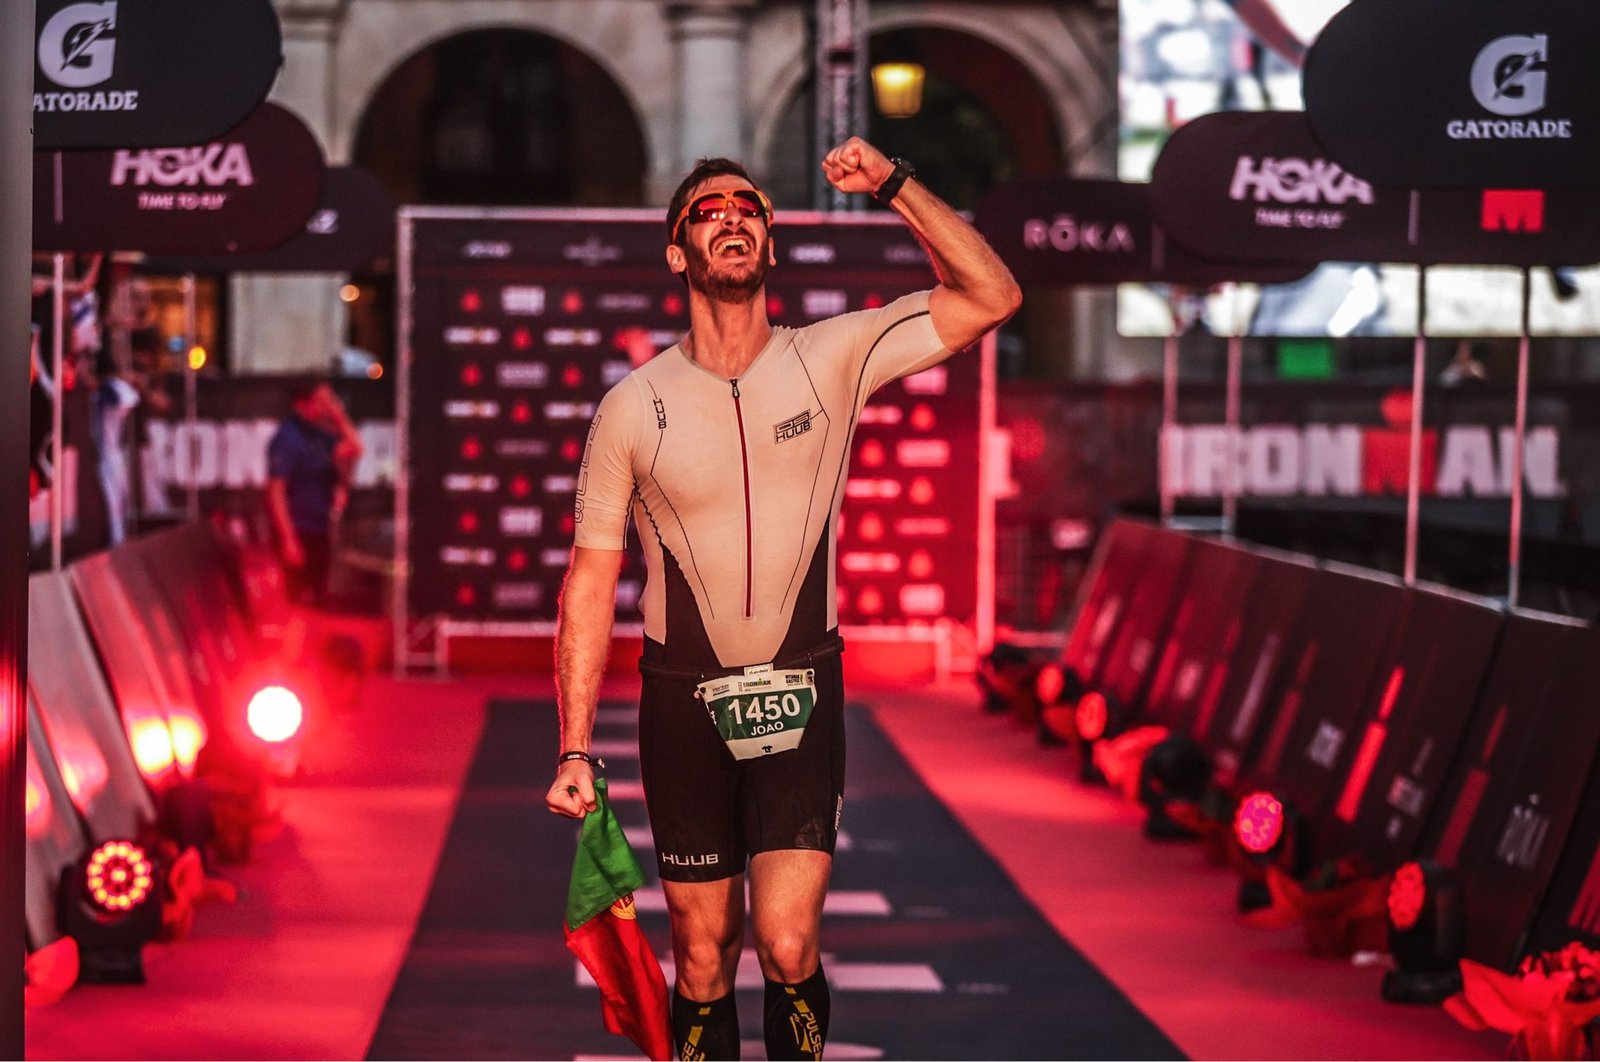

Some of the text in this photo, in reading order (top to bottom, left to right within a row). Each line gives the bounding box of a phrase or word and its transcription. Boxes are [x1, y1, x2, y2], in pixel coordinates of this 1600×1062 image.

[33, 90, 139, 112] ATORADE
[1447, 119, 1572, 139] GATORADE
[111, 144, 253, 186] HOKA
[1228, 155, 1375, 205] HOKA
[653, 398, 667, 430] HUUB
[776, 421, 811, 442] HUUB
[1159, 424, 1559, 496] IRONMAN
[728, 693, 800, 724] 1450
[750, 721, 784, 736] JOAO
[662, 852, 719, 866] HUUB
[800, 1012, 822, 1054] PULSE
